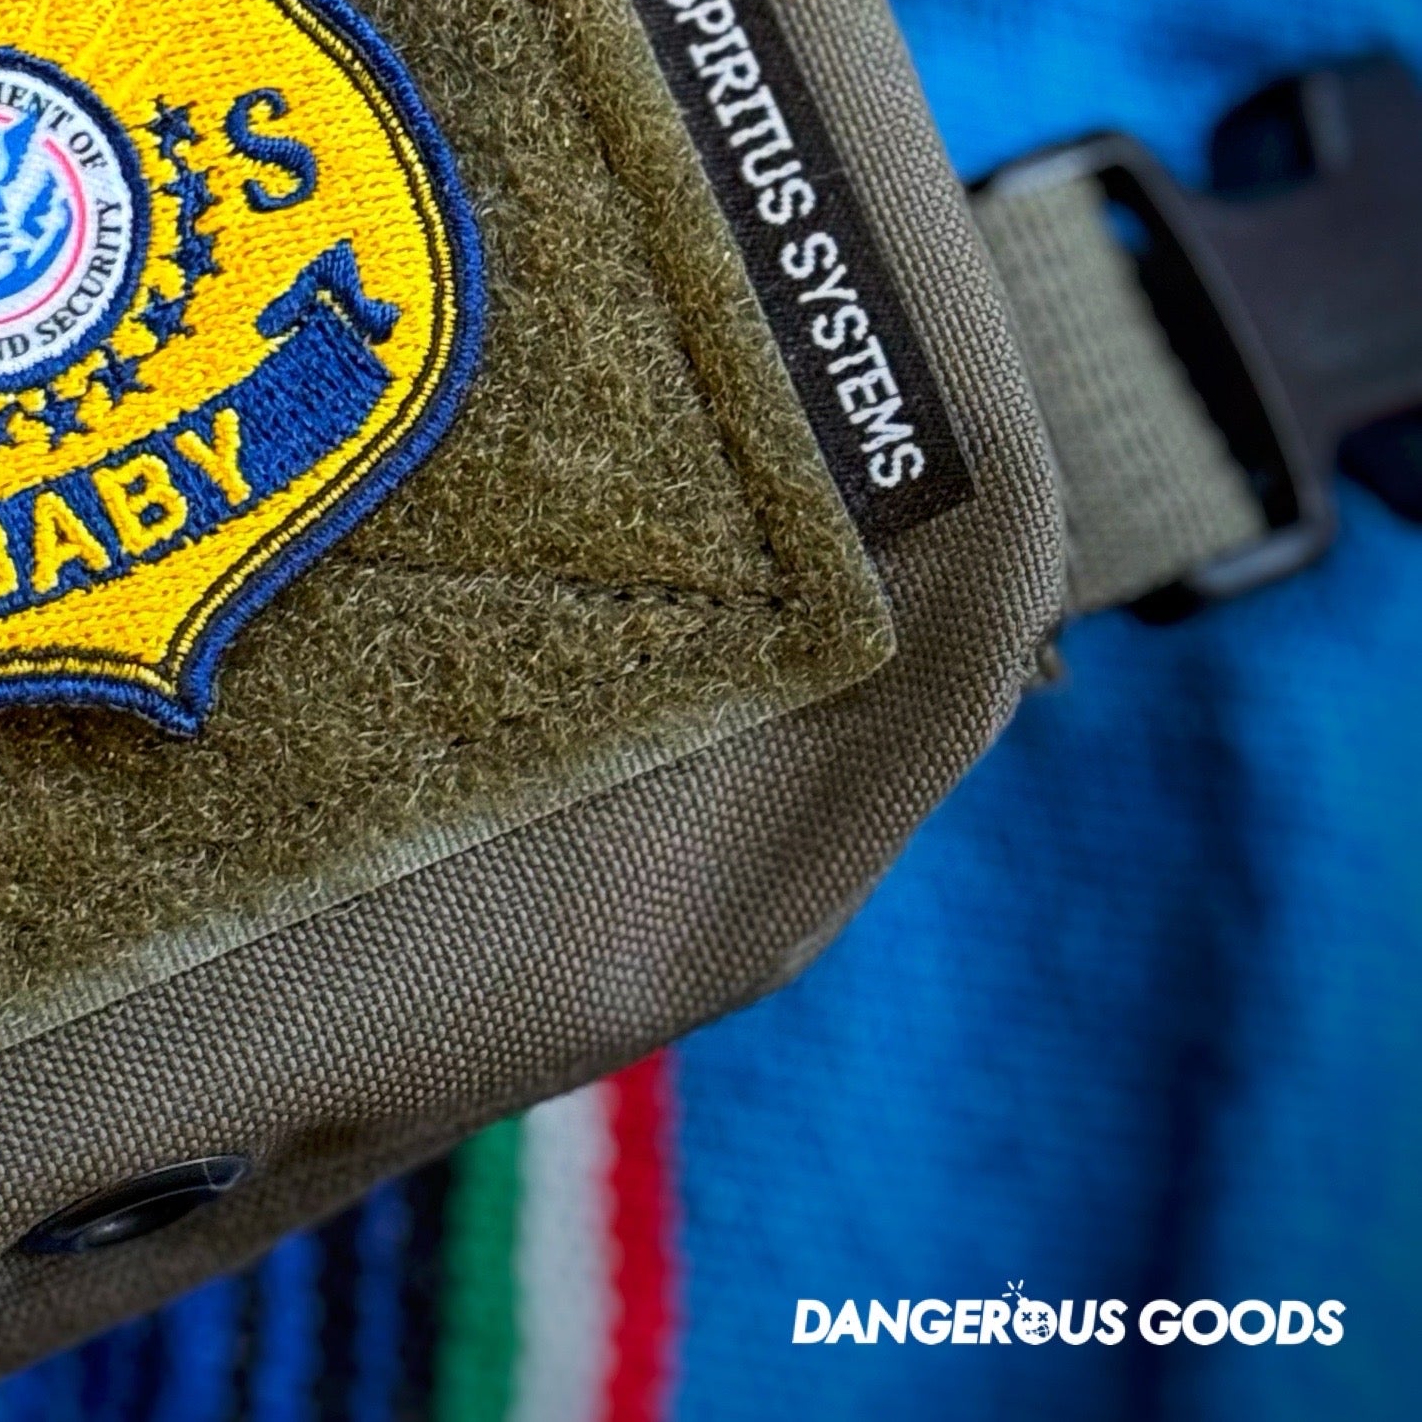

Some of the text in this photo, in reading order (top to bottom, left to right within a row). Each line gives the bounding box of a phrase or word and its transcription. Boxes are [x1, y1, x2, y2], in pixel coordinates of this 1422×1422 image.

[68, 130, 109, 171] OF
[222, 87, 320, 212] S
[36, 198, 123, 346] SECURITY
[780, 231, 925, 488] SYSTEMS
